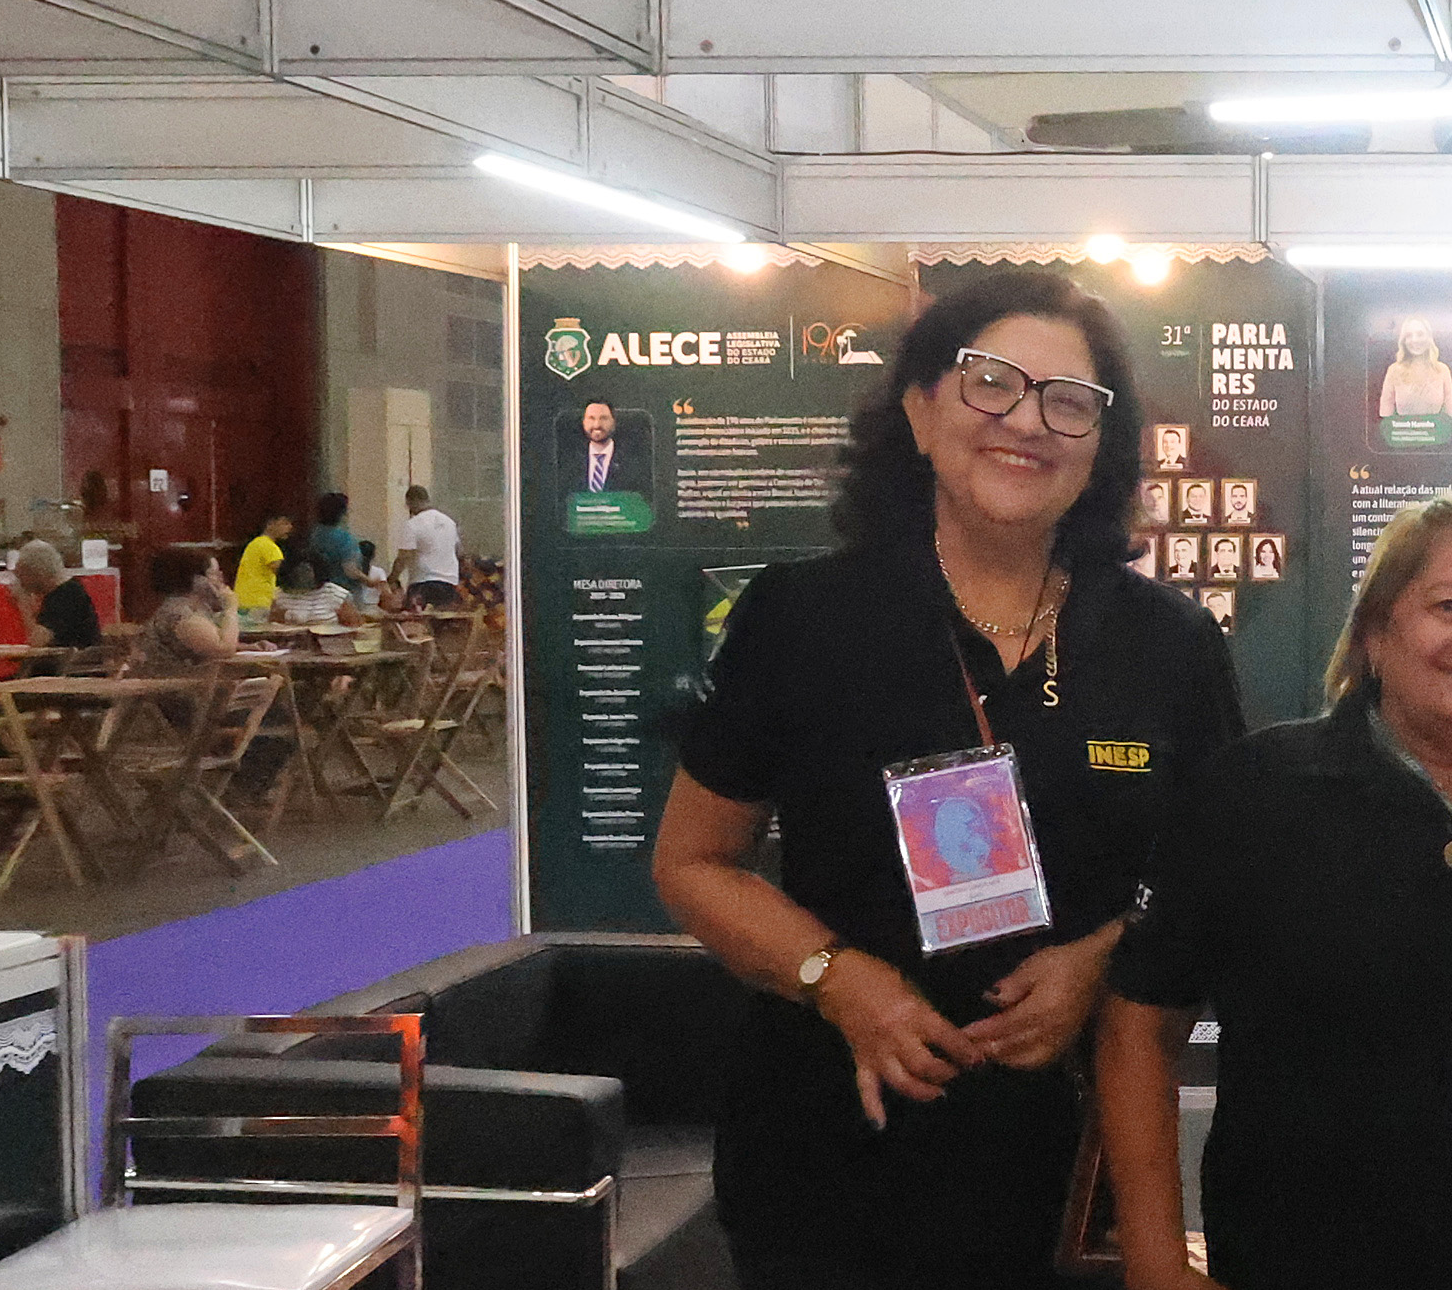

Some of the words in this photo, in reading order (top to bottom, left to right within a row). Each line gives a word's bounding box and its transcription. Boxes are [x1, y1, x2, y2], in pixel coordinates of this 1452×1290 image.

[1212, 323, 1286, 345] PARLA
[598, 332, 721, 365] ALECE
[1212, 348, 1294, 369] MENTA
[1212, 373, 1255, 394] RES
[1212, 399, 1230, 410] DO
[1233, 399, 1278, 410] ESTADO
[1212, 415, 1230, 427] DO
[1233, 413, 1270, 427] CEARÁ
[1352, 485, 1359, 494] A
[1360, 485, 1383, 494] atual
[1384, 484, 1417, 497] relação
[1418, 484, 1434, 494] das
[1352, 500, 1370, 508] com
[1372, 500, 1378, 508] a
[1352, 514, 1366, 522] um
[1088, 745, 1150, 767] INESP
